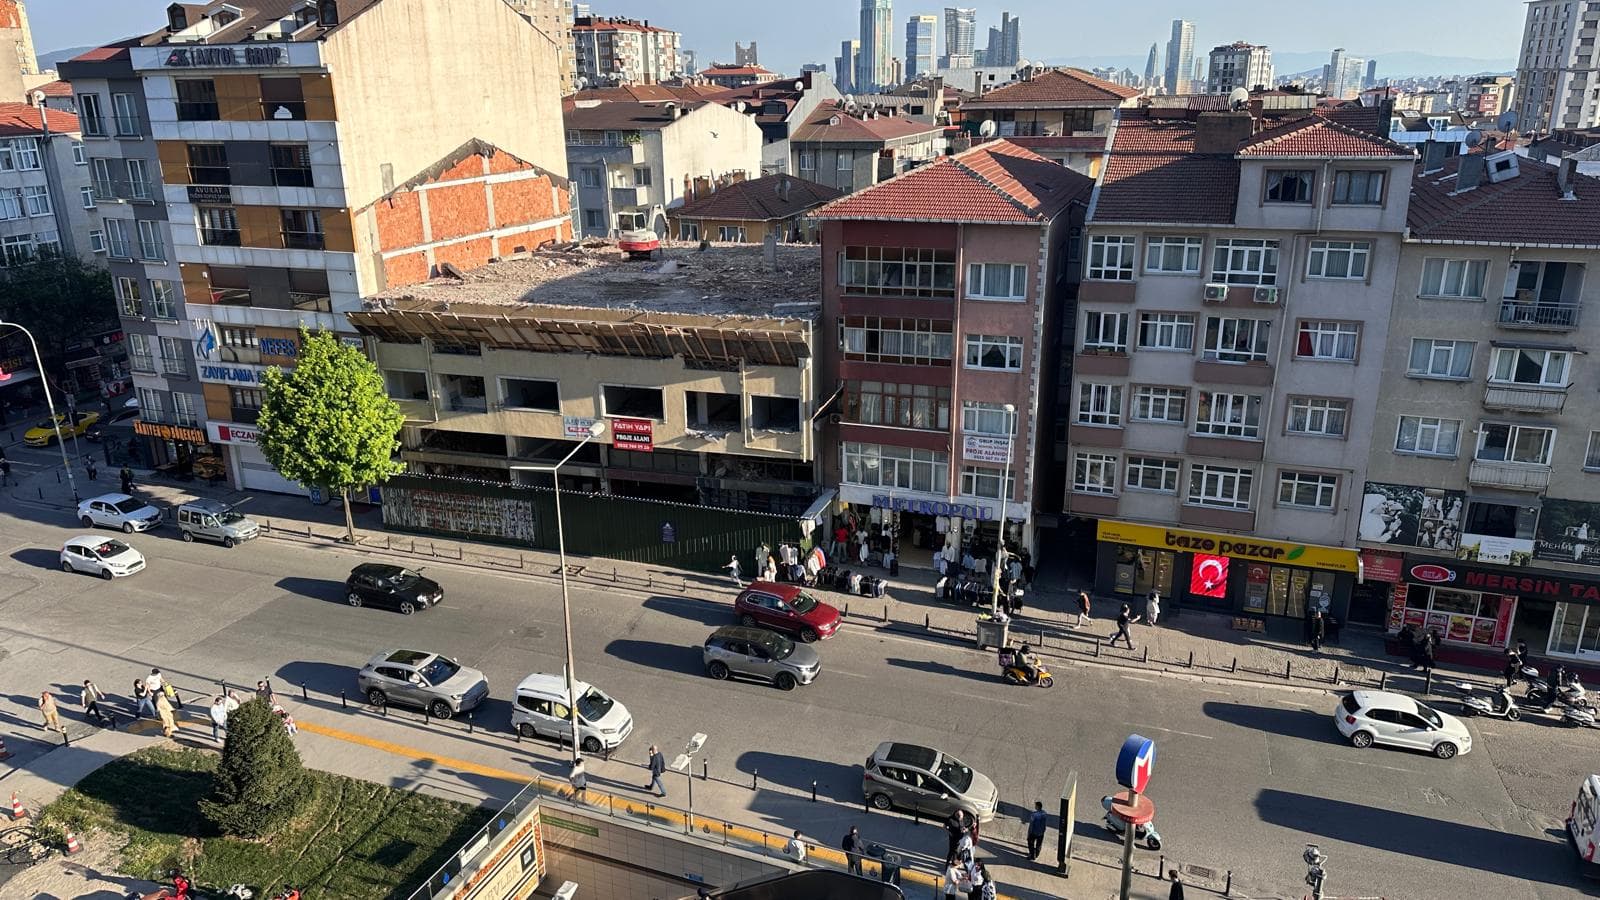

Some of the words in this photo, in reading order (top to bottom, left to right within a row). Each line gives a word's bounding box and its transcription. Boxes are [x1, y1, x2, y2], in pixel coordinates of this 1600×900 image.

[196, 47, 239, 66] AKYOL
[245, 47, 281, 65] GRUP
[261, 338, 296, 357] NEFES
[201, 366, 255, 383] ZAYIFLAMA
[872, 495, 993, 520] METROPOL
[1219, 540, 1285, 560] pazar
